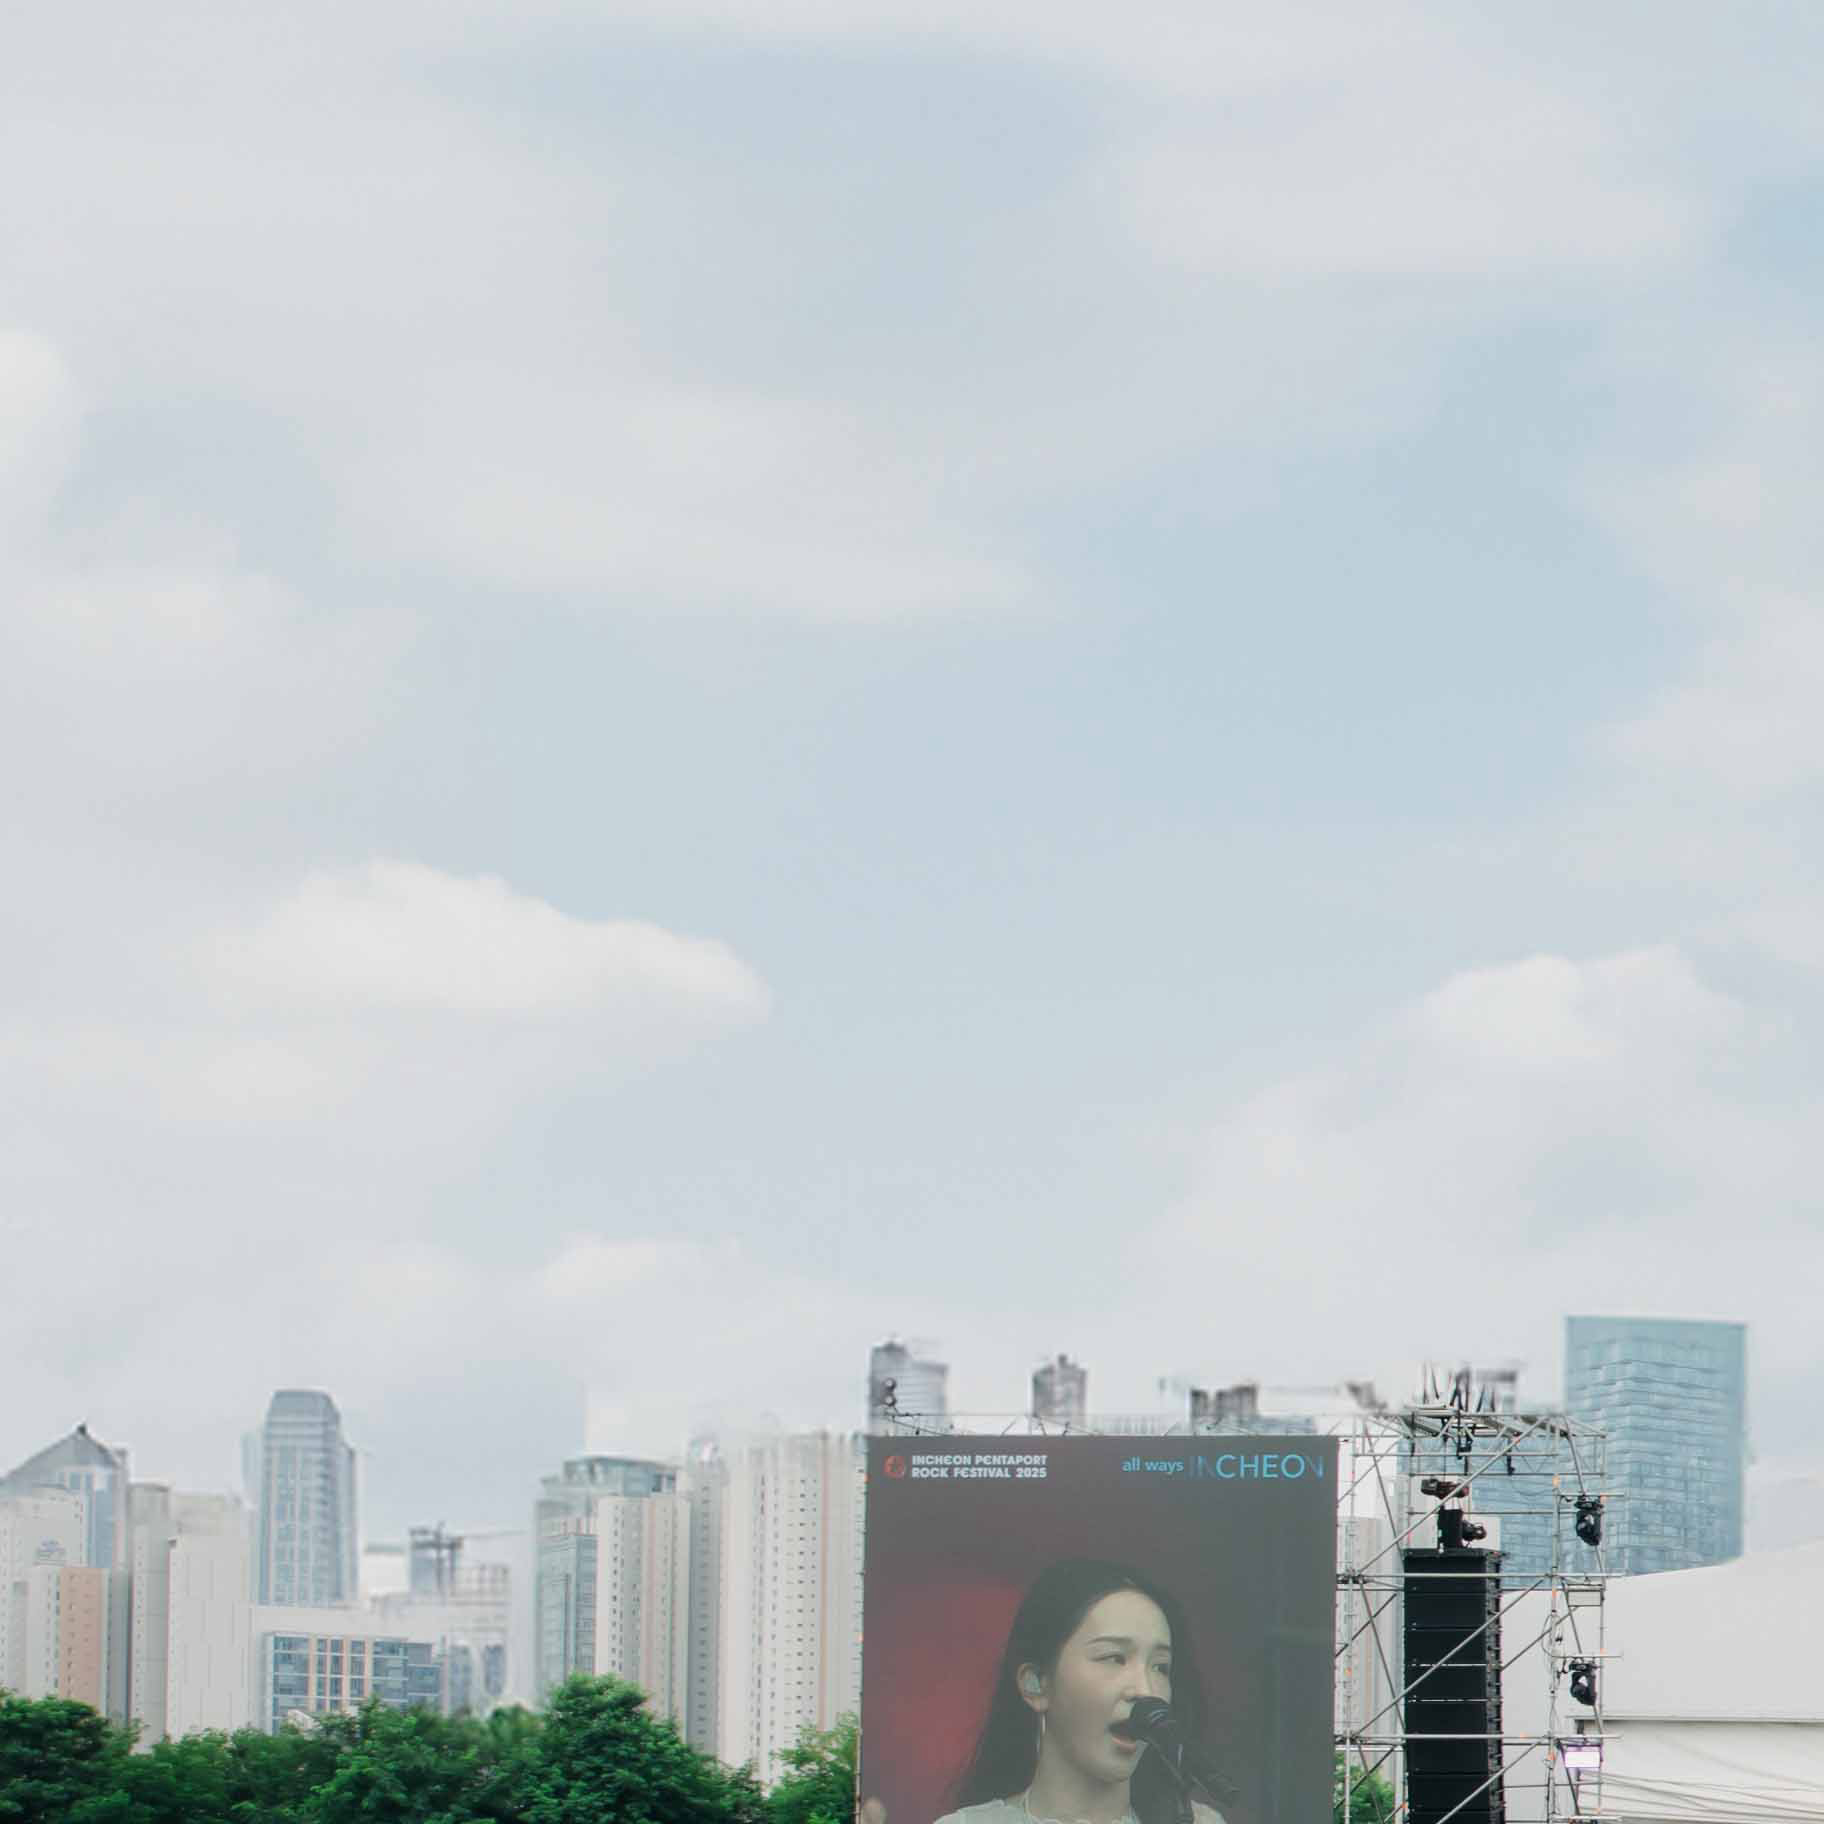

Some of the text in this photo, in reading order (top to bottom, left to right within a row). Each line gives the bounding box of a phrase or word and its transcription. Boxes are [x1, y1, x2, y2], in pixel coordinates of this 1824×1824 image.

[911, 1455, 1047, 1466] INCHEON PENTAPORT
[911, 1467, 1047, 1478] ROCK FESTIVAL 2025
[1122, 1459, 1142, 1472] all
[1145, 1460, 1184, 1475] ways
